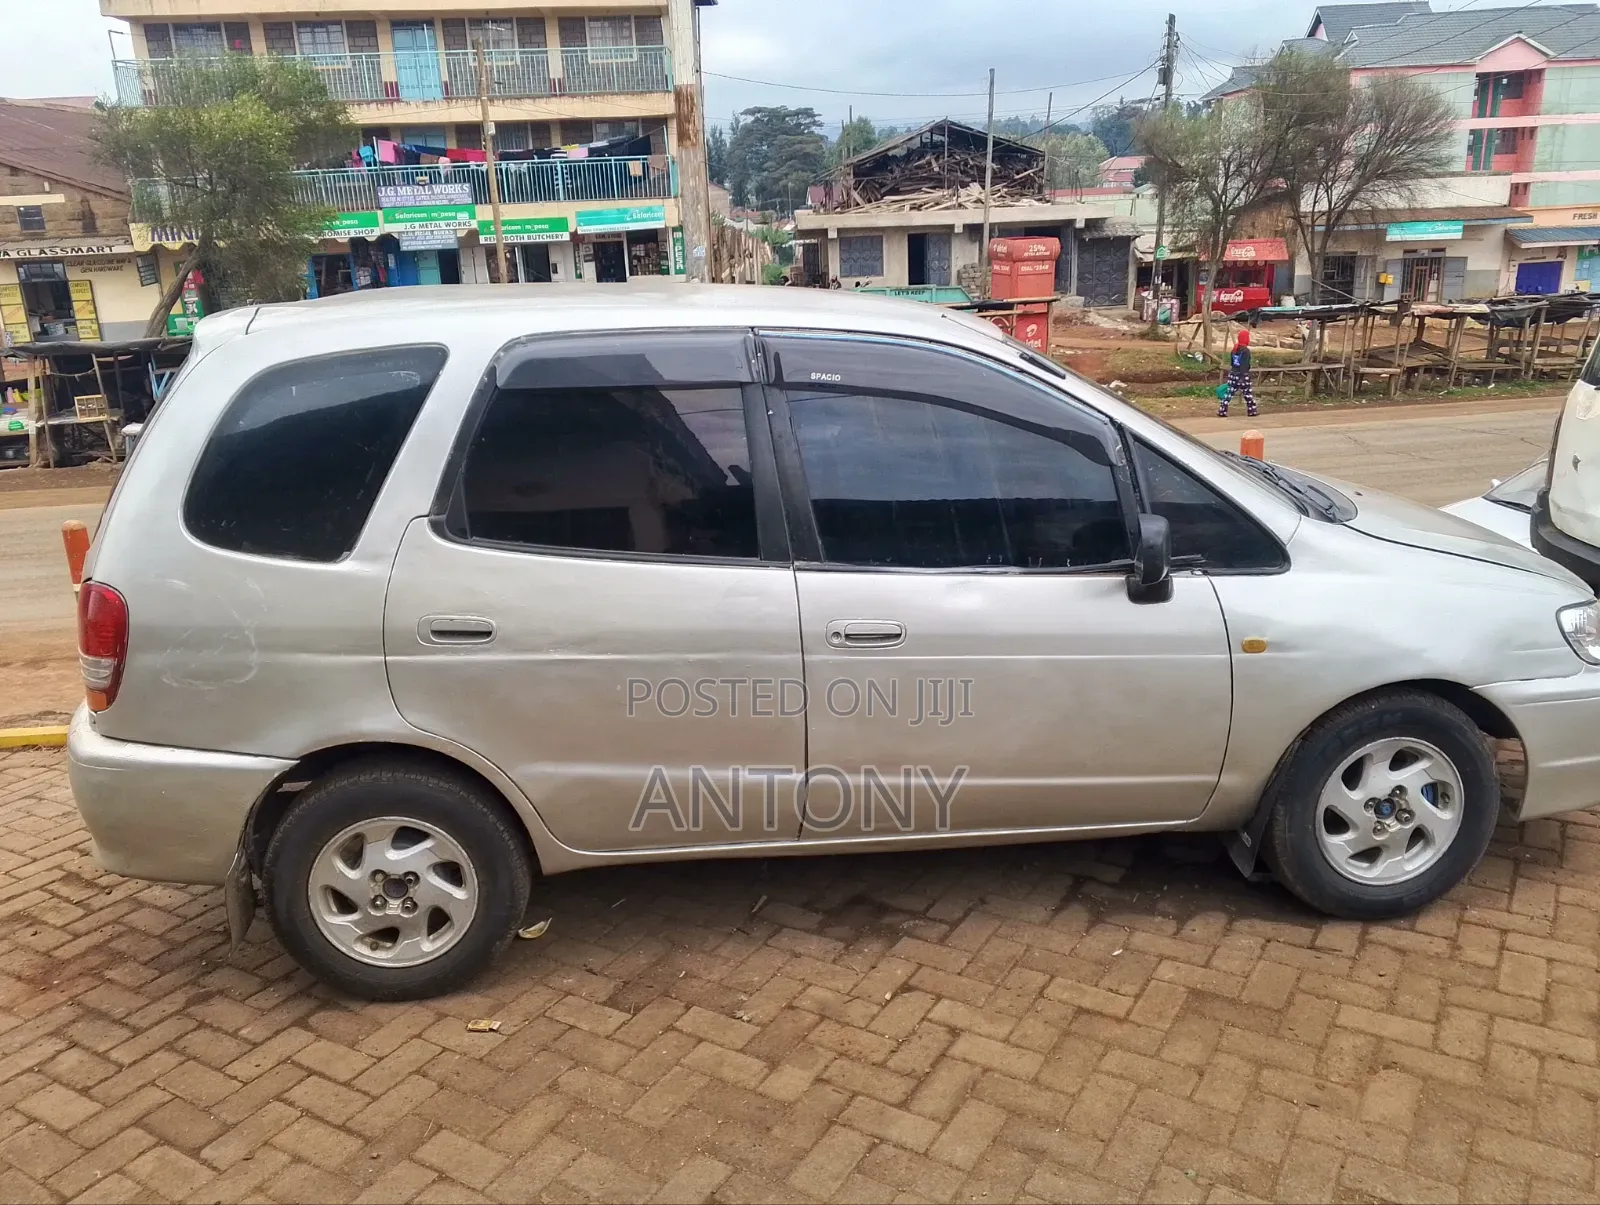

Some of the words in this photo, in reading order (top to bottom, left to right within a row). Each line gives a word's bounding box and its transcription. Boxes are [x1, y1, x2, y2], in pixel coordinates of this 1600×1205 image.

[397, 185, 431, 195] METAL
[432, 184, 469, 194] WORKS
[632, 211, 664, 219] Safaricom
[1572, 212, 1598, 220] FRESH
[483, 234, 525, 242] REHBOTH
[527, 233, 564, 241] BUTCHERY
[17, 245, 116, 257] GLASSMART
[810, 372, 841, 381] SPACIO
